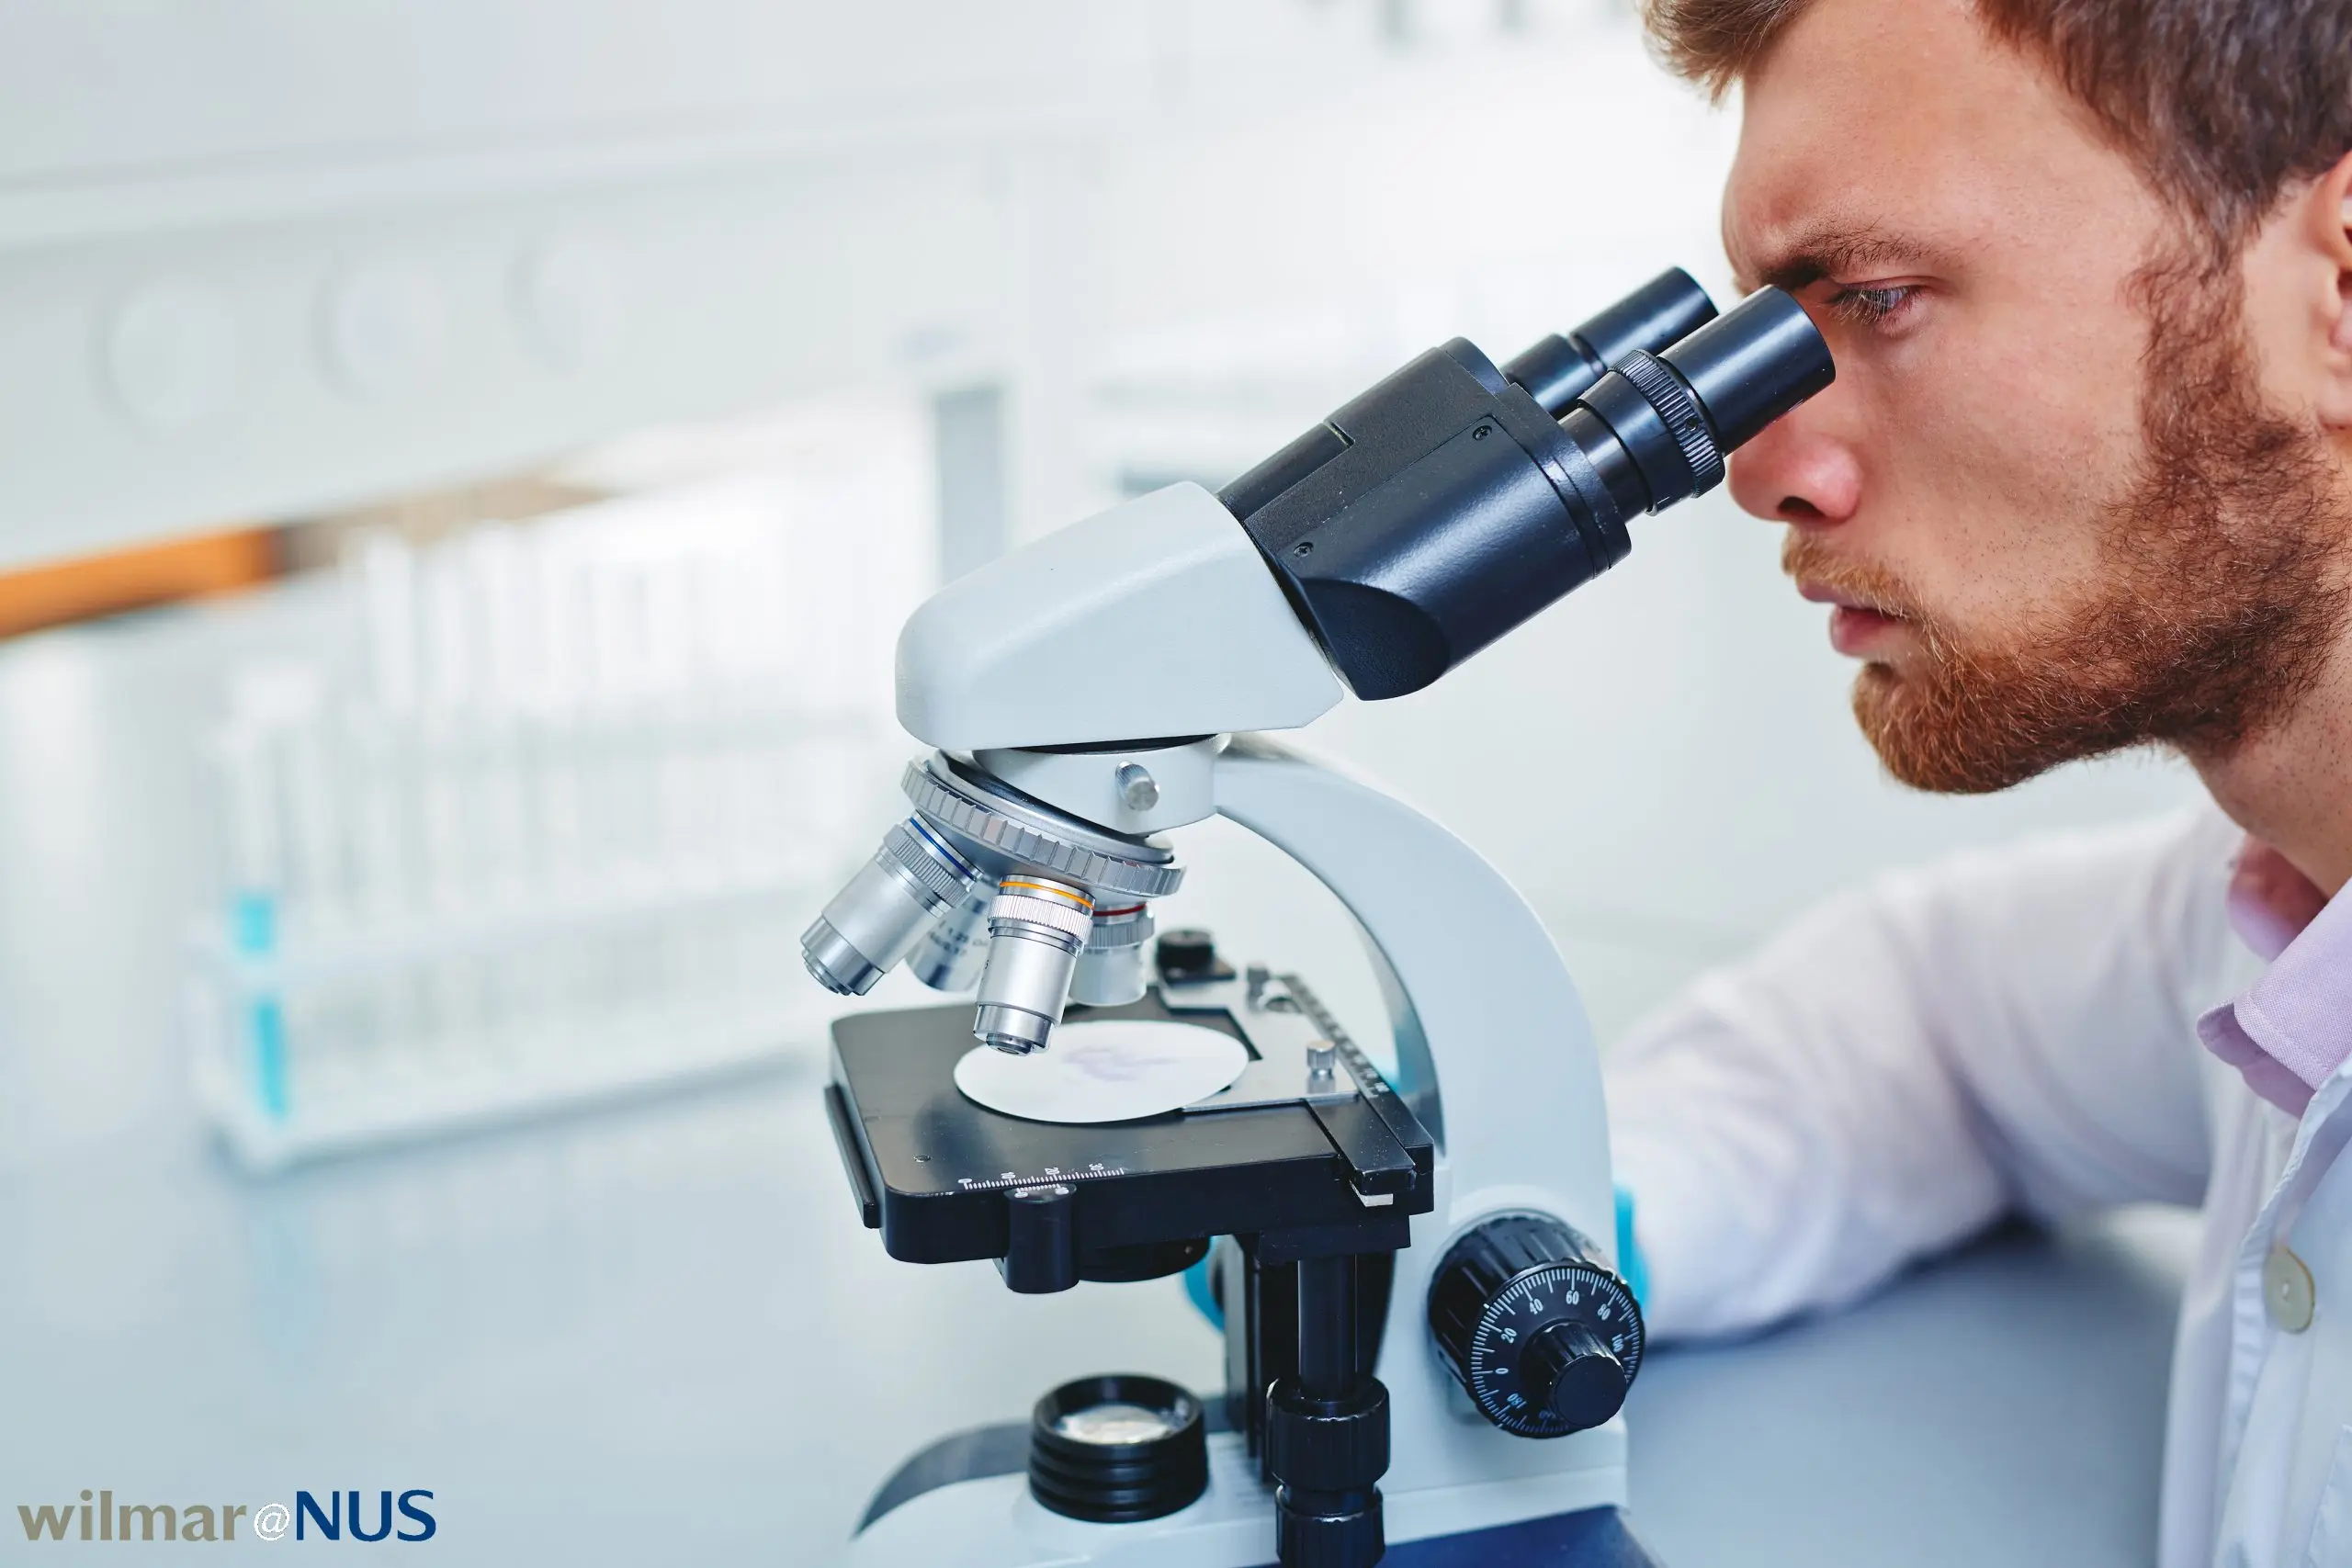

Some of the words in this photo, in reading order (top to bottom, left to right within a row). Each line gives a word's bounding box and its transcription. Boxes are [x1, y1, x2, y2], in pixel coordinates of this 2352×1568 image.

[1566, 1291, 1579, 1305] 60
[1529, 1299, 1544, 1315] 40
[1597, 1303, 1611, 1320] 80
[1500, 1327, 1517, 1344] 20
[1611, 1334, 1623, 1352] 100
[1495, 1367, 1509, 1375] 0
[1507, 1393, 1527, 1408] 180
